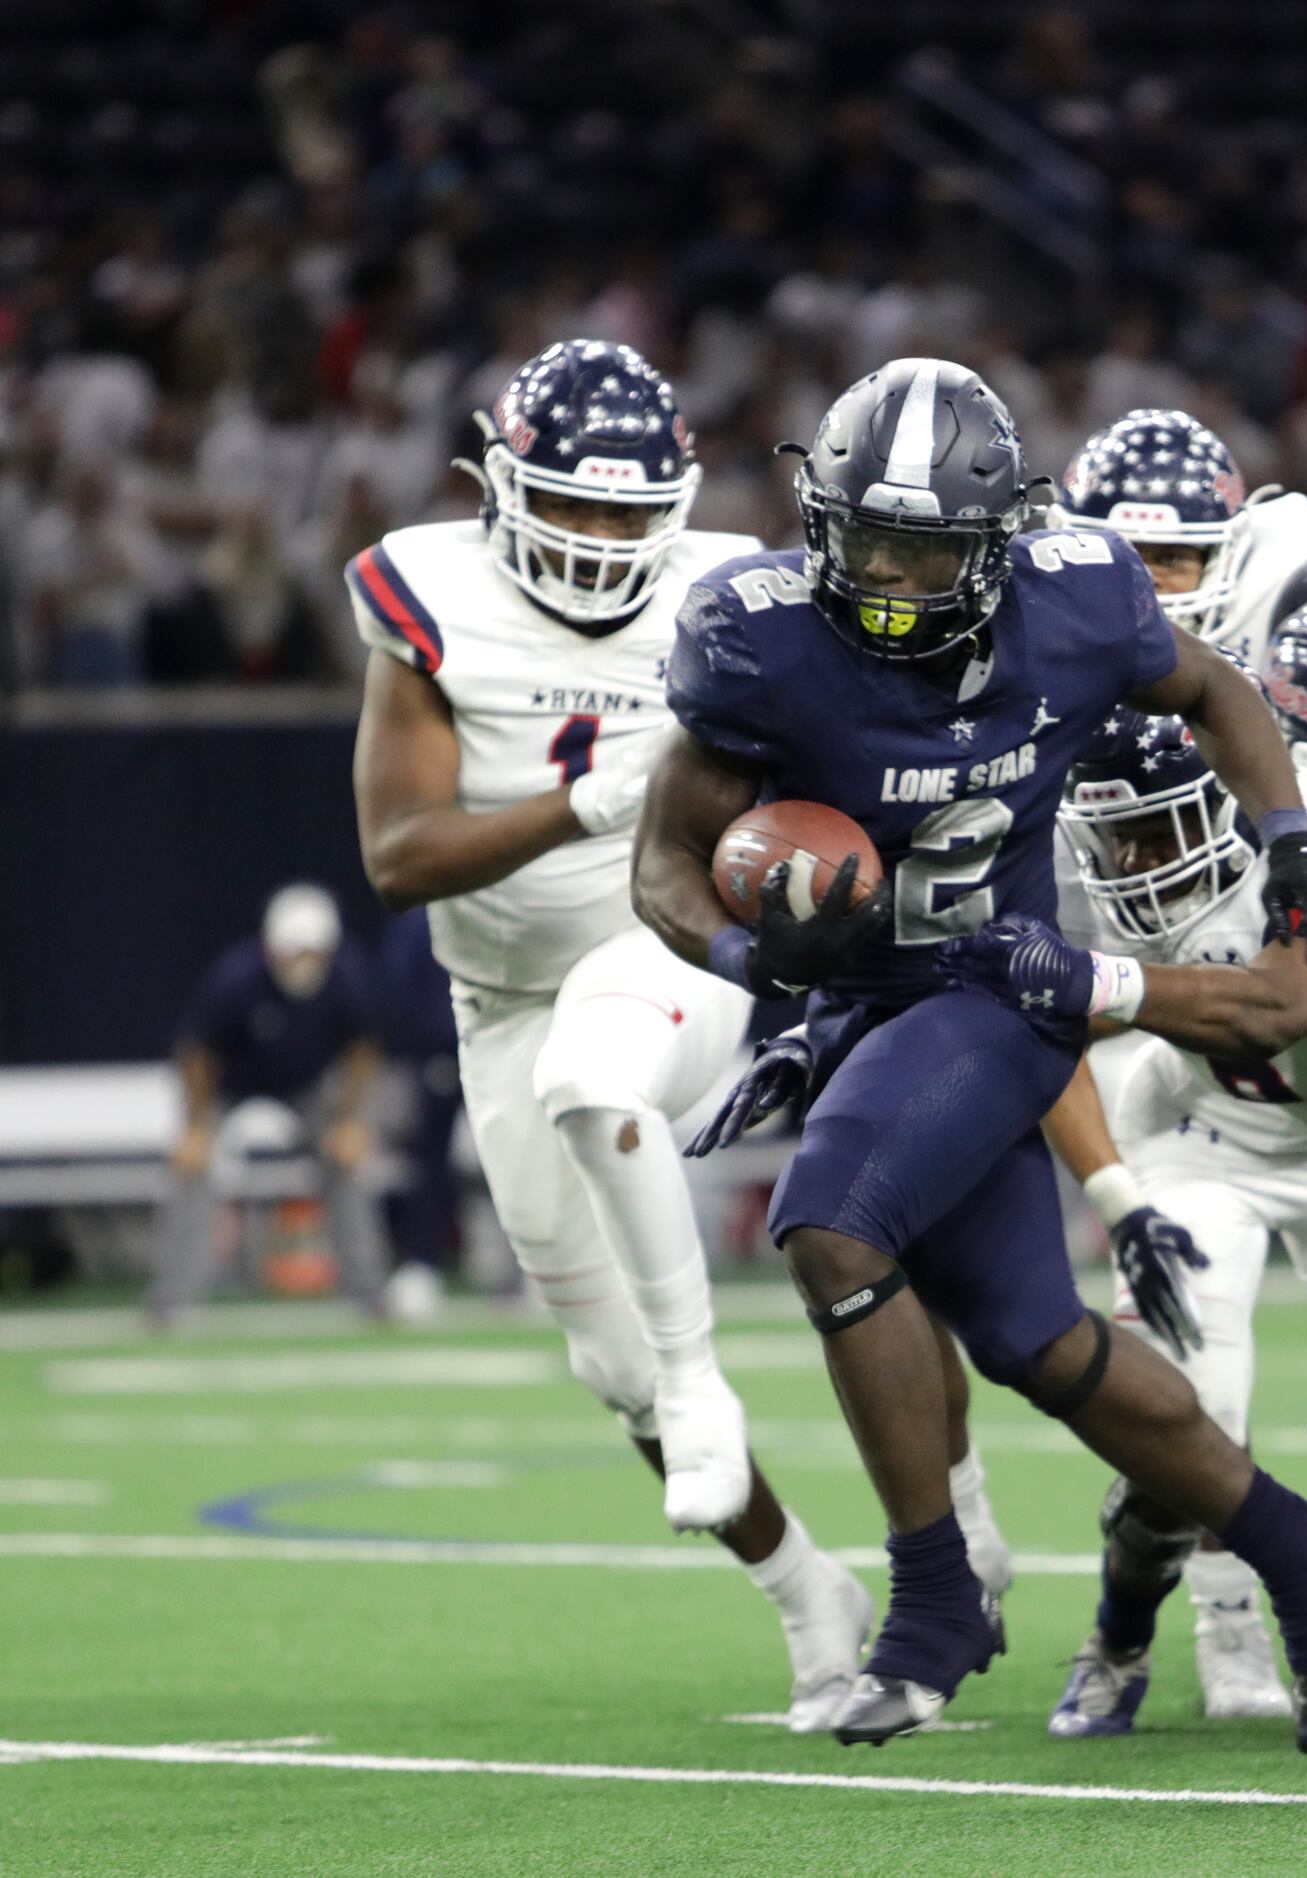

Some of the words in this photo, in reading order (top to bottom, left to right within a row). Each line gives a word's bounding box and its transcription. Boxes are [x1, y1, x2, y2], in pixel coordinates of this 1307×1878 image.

[1029, 532, 1114, 573] 2
[729, 565, 815, 613] 2
[551, 689, 623, 711] RYAN
[546, 712, 601, 788] 1
[880, 767, 958, 803] LONE
[966, 742, 1037, 792] STAR
[894, 796, 1014, 945] 2
